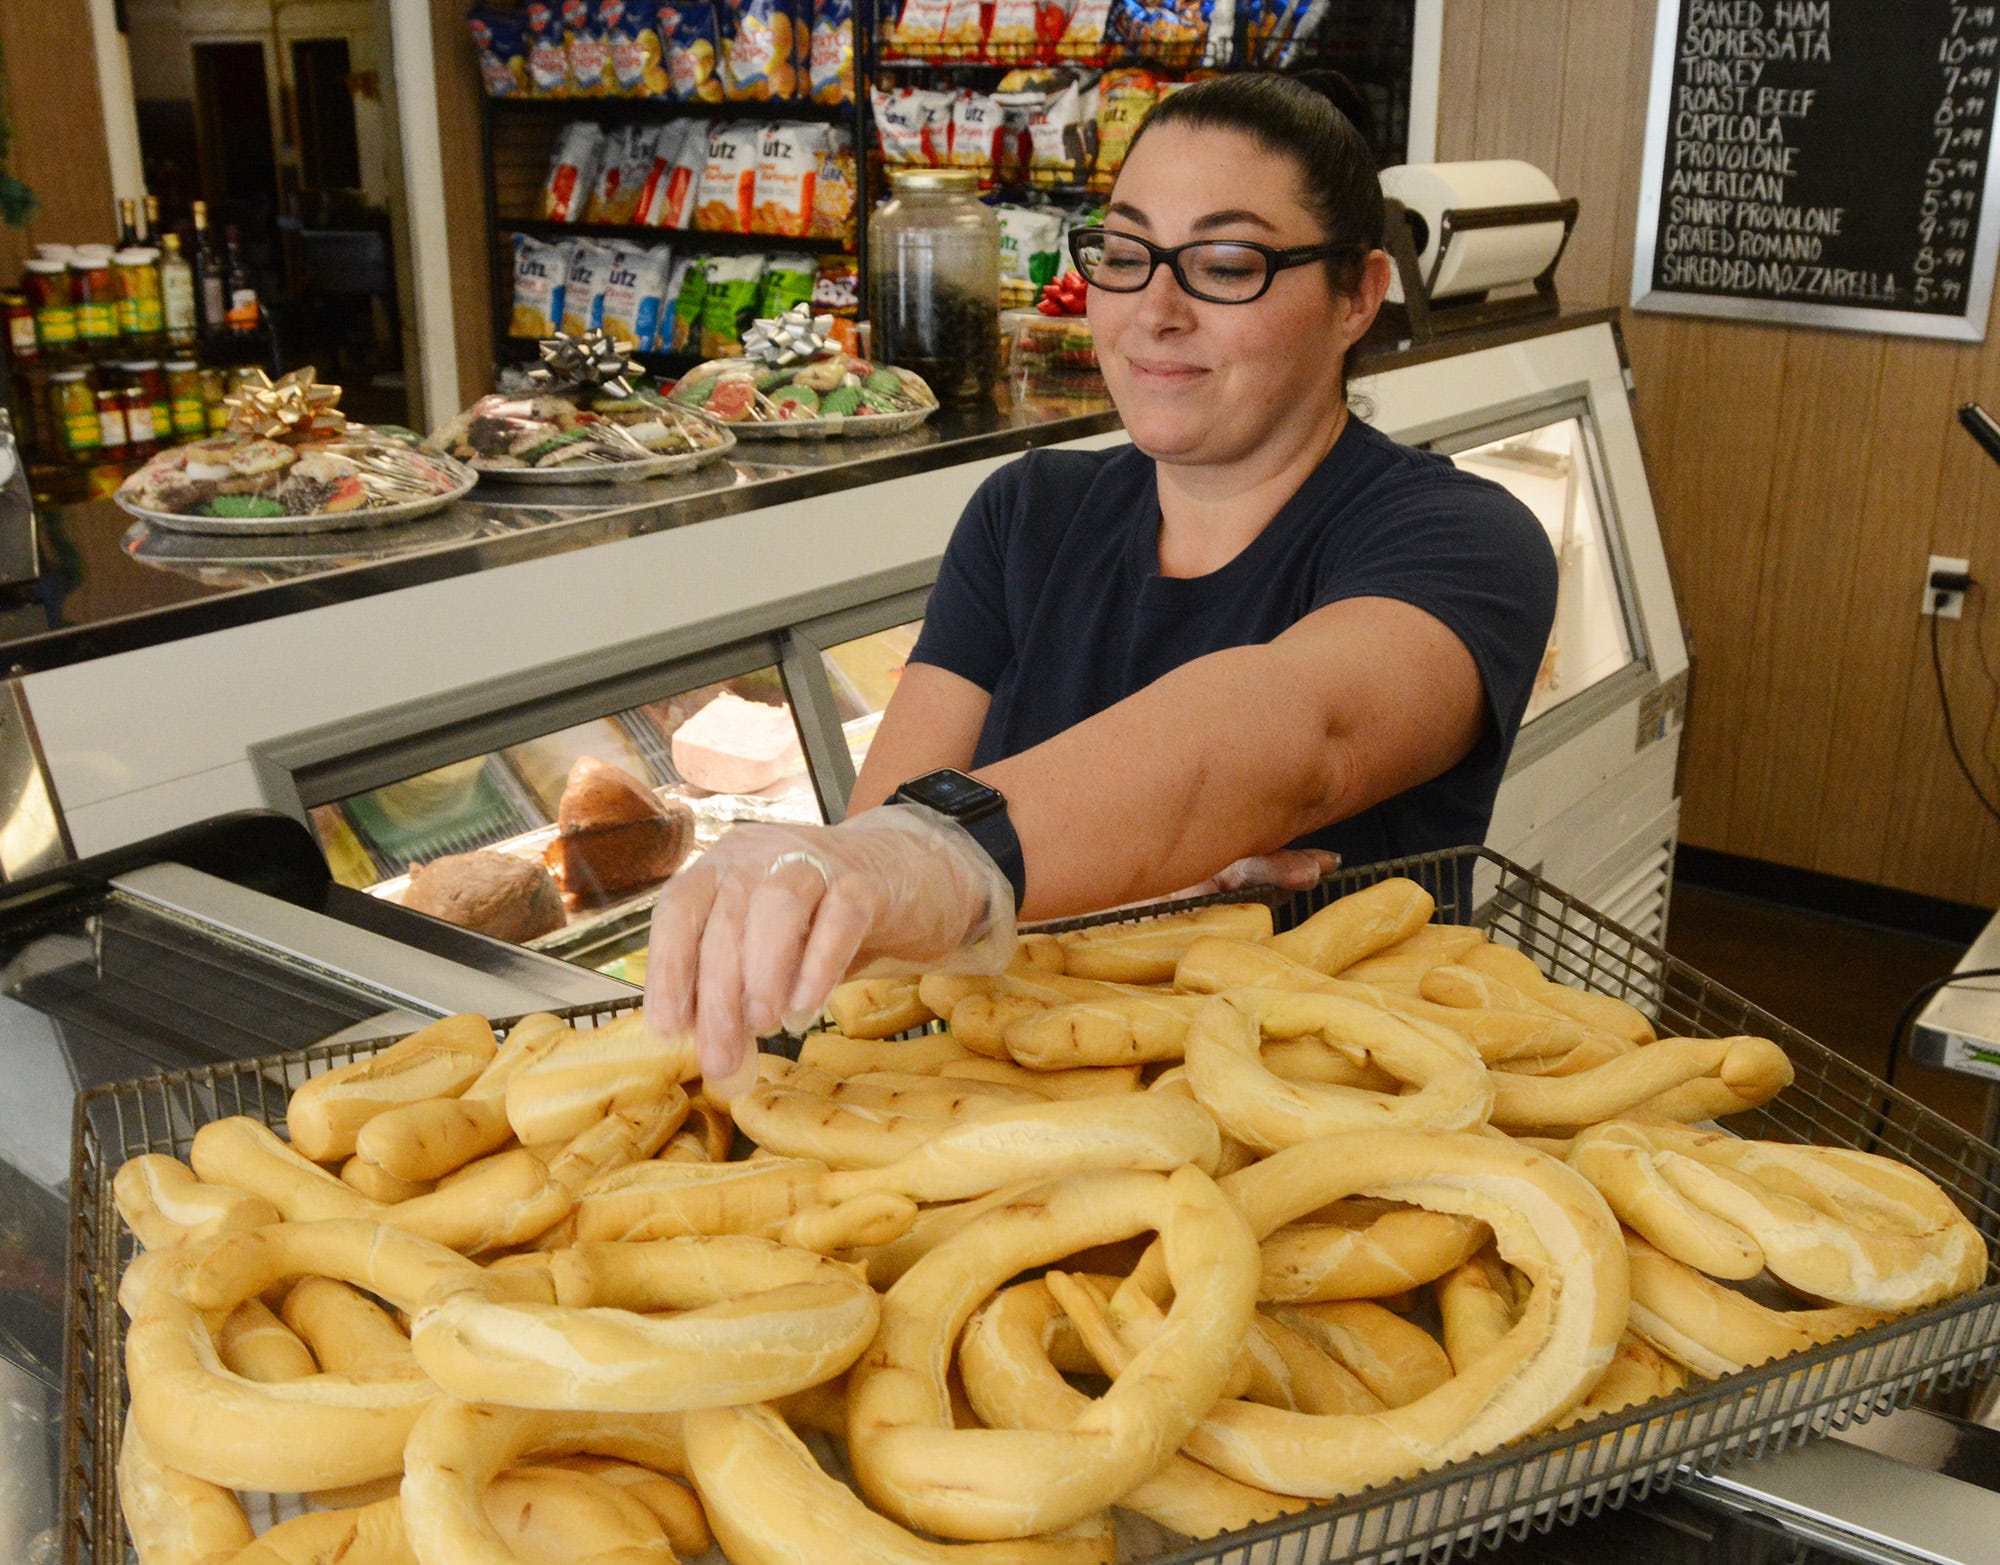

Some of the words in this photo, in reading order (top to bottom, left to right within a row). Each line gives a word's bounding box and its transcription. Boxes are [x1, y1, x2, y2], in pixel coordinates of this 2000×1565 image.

[1688, 0, 1764, 27] BAKED
[1775, 1, 1830, 31] HAM
[1682, 25, 1831, 62] SOPRESSATA
[1680, 56, 1765, 87] TURKEY
[1679, 85, 1749, 113] ROAST
[1757, 87, 1817, 119] BEEF
[1675, 111, 1784, 145] CAPICOLA
[1675, 140, 1800, 176] PROVOLONE
[1668, 169, 1783, 203] AMERICAN
[1670, 195, 1734, 225] SHARP
[1735, 201, 1845, 236] PROVOLONE
[1664, 224, 1735, 254] GRATED
[1739, 230, 1822, 261] ROMANO
[1662, 252, 1756, 289] SHREDDED
[1758, 262, 1896, 300] MOZZARELLA
